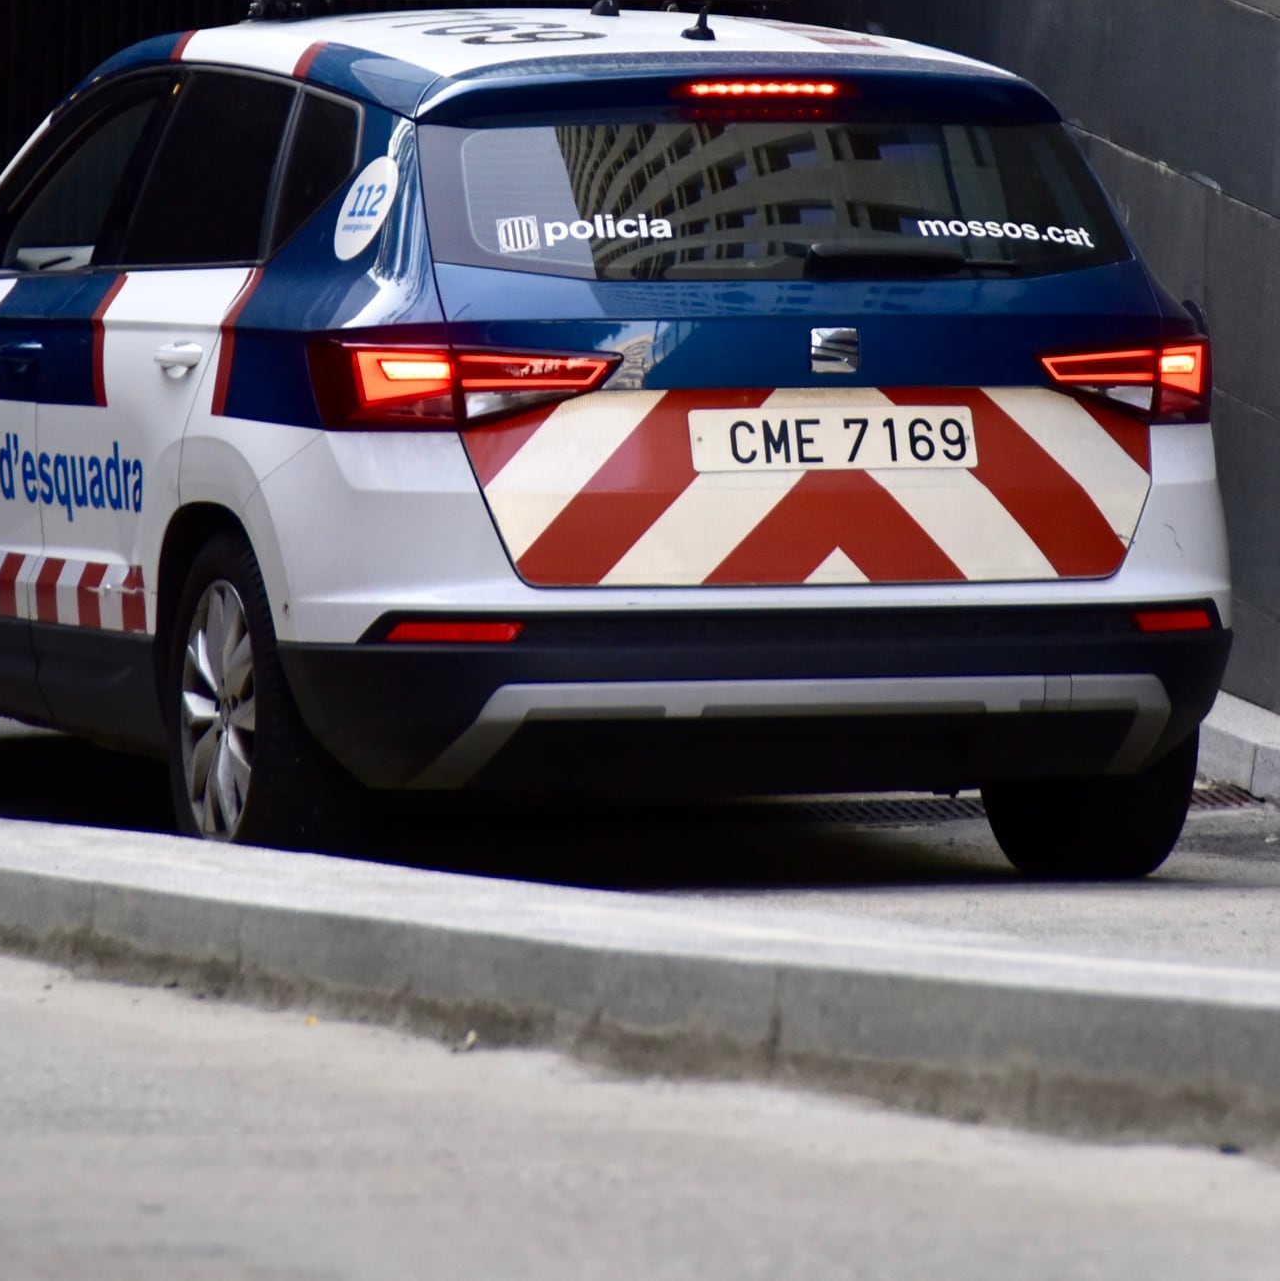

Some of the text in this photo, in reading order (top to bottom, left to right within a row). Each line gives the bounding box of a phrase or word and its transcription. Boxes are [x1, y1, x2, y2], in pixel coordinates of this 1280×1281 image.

[347, 183, 388, 218] 112
[543, 213, 673, 247] policia
[917, 219, 1095, 248] mossos.cat
[729, 417, 967, 465] CME 7169
